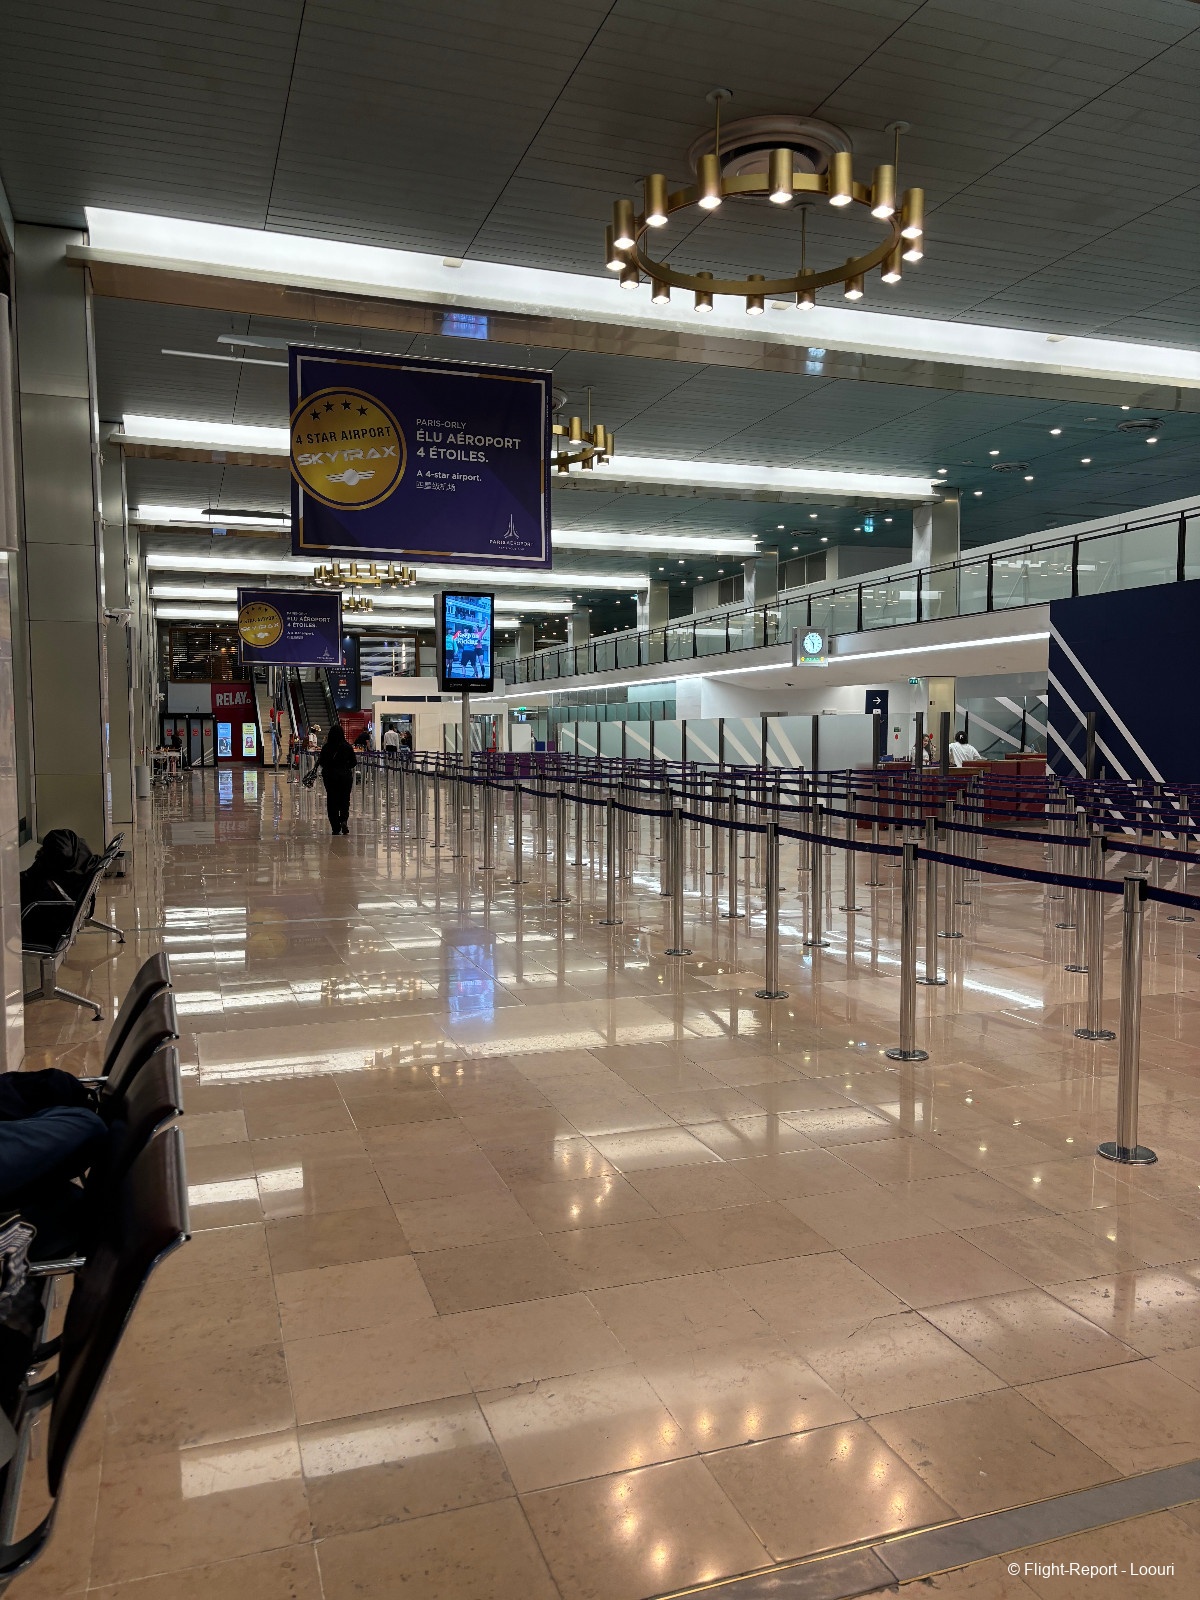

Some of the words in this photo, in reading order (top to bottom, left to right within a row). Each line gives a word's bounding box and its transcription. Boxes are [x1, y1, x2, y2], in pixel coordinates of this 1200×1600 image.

[416, 418, 467, 430] PARIS-ORLY
[296, 434, 303, 445] 4
[306, 431, 338, 444] STAR
[341, 426, 391, 441] AIRPORT
[416, 428, 442, 443] ÉLU
[446, 431, 521, 450] AÉROPORT
[297, 445, 397, 466] SKYTRAX
[416, 446, 426, 458] 4
[429, 445, 489, 463] ÉTOILES.
[416, 469, 423, 477] A
[425, 470, 450, 479] 4-star
[451, 472, 482, 482] airport.
[216, 691, 247, 706] RELAY
